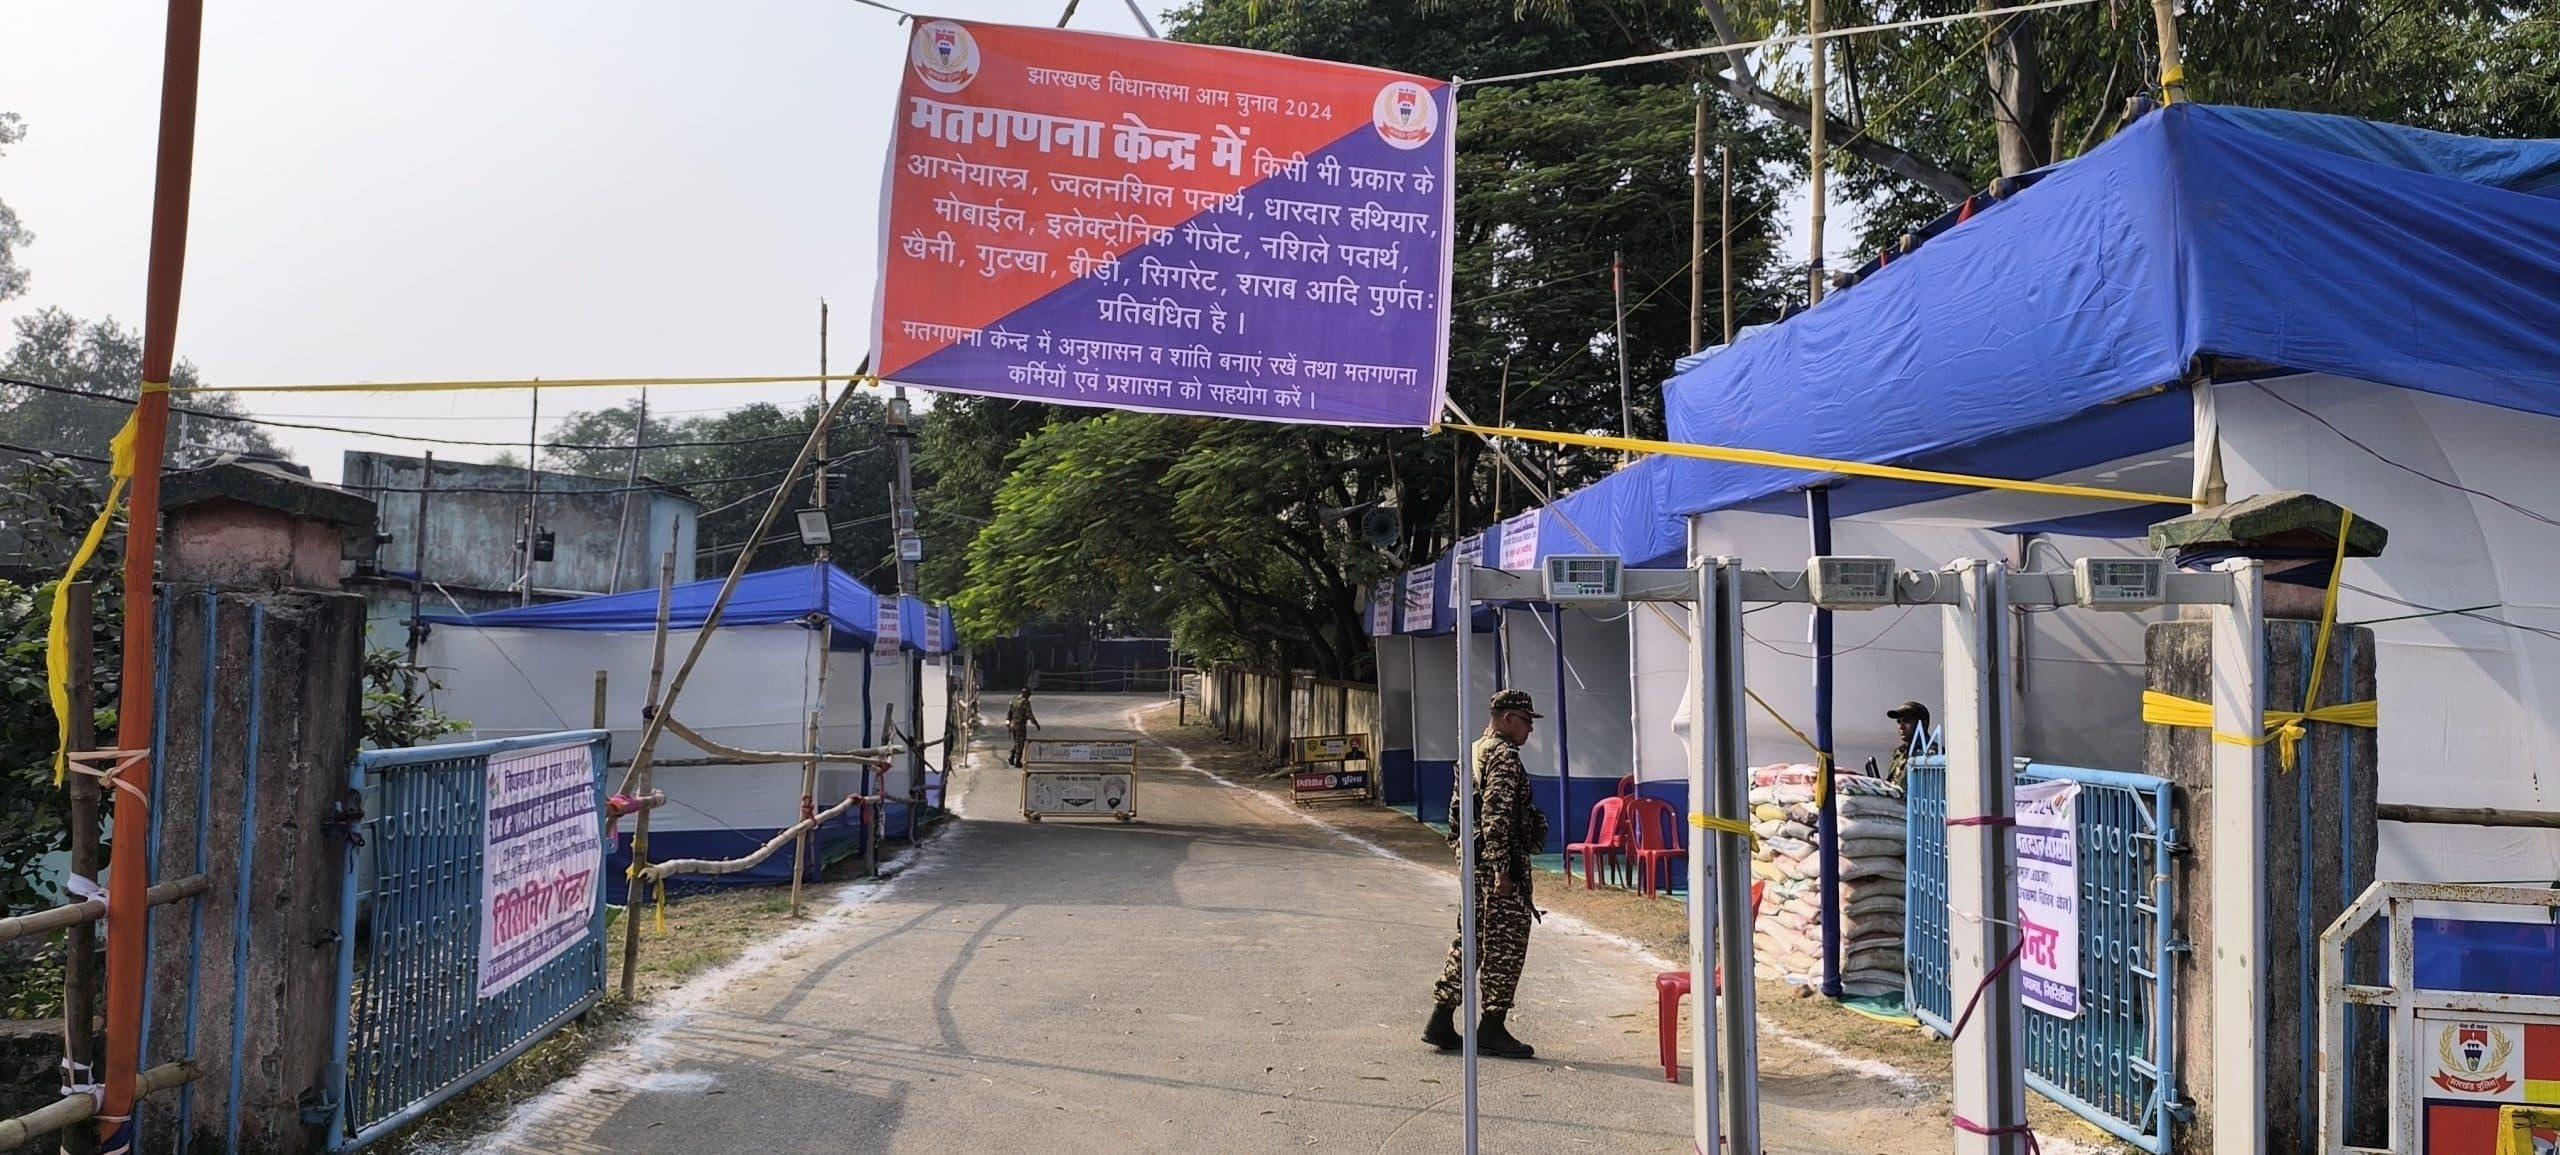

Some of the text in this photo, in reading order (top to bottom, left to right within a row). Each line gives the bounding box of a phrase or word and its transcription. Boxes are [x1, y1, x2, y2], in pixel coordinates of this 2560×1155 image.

[1027, 66, 1332, 121] झारखण्ड विधानसभा आम चुनाव 2024
[910, 96, 1435, 195] मतगणना केन्द्र में किसी भी प्रकार के
[907, 153, 1437, 238] आग्नेयास्त्र, ज्वलनशिल पदार्थ, धारदार हथियार,
[932, 191, 1409, 274] मोबाईल, इलेक्ट्रोनिक गैजेट, नशिले पदार्थ,
[900, 227, 1434, 317] खैनी, गुटखा, बीड़ी, सिगरेट, शराब आदि पुर्णत:
[1097, 293, 1201, 330] प्रतिबंधित
[1209, 302, 1227, 334] है
[901, 320, 983, 347] मतगणना
[989, 325, 1030, 352] केन्द्र
[1036, 329, 1052, 354] में
[1058, 336, 1143, 365] अनुशासन
[1169, 344, 1212, 370] शांति
[1218, 350, 1262, 377] बनाएं
[1268, 352, 1297, 377] रखें
[1303, 359, 1337, 380] तथा
[1343, 363, 1417, 386] मतगणना
[1008, 361, 1067, 388] कर्मियों
[1073, 367, 1100, 393] एवं
[1105, 374, 1172, 398] प्रशासन
[1179, 376, 1202, 400] को
[1208, 380, 1267, 405] सहयोग
[1274, 384, 1301, 409] करें
[493, 877, 552, 947] रिसिविंग
[2019, 908, 2059, 970] ेन्टर
